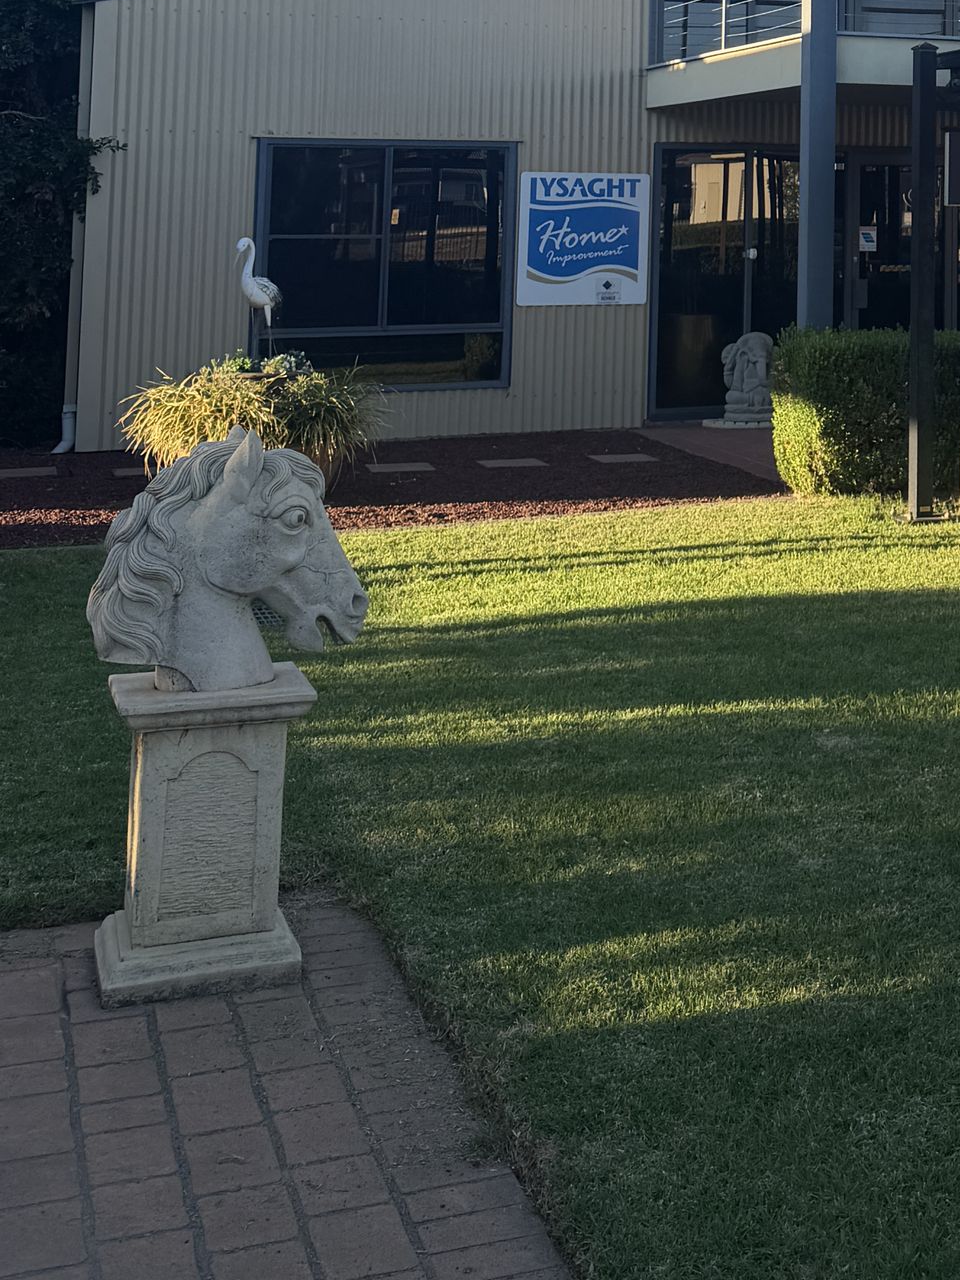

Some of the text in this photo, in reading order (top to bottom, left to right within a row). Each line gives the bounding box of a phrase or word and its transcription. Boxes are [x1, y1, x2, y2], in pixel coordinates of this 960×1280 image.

[530, 177, 641, 204] LYSAGHT
[536, 216, 622, 253] Home
[546, 244, 629, 267] Improvement
